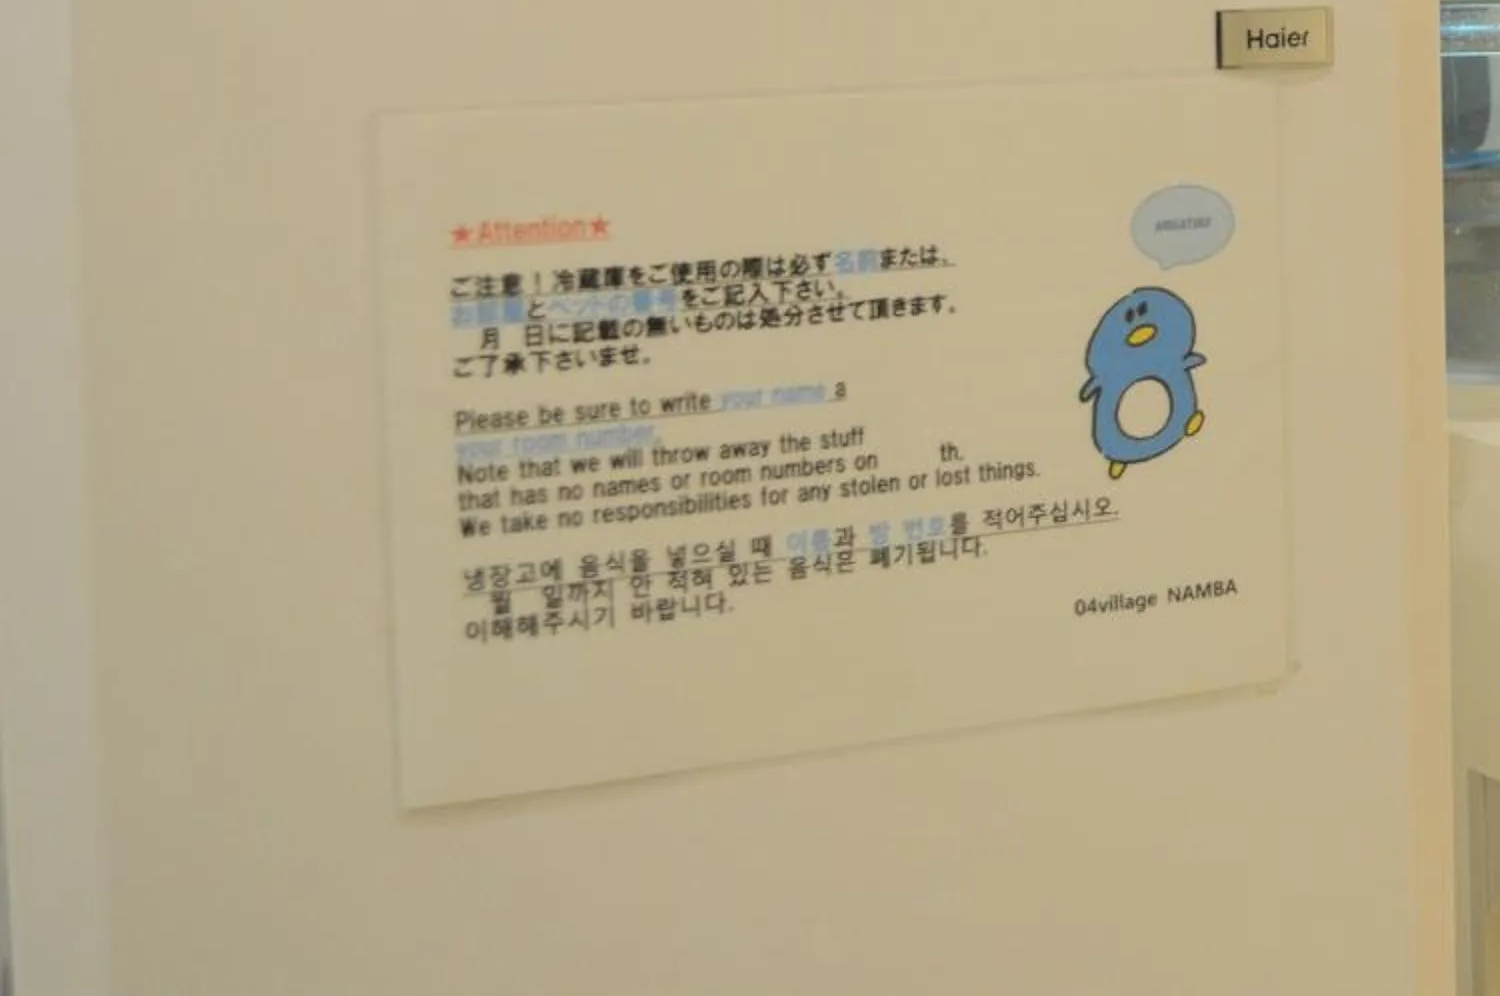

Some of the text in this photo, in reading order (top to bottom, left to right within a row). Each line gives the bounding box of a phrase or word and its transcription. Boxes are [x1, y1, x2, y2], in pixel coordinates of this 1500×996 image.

[1246, 27, 1309, 49] Haier
[478, 217, 586, 241] Attention
[480, 326, 500, 350] 月
[455, 408, 529, 430] Please
[538, 405, 564, 424] be
[575, 401, 622, 422] sure
[630, 397, 651, 416] to
[660, 392, 712, 413] write
[834, 381, 847, 399] a
[458, 425, 864, 485] Note that we will throw away the stuff
[459, 441, 965, 512] that has no names or room numbers on th.
[460, 459, 1041, 539] We take no responsibilities for any stolen or lost things.
[463, 557, 563, 592] 냉장고에
[578, 547, 650, 580] 음식을
[667, 538, 737, 570] 넣으실
[751, 534, 773, 558] 때
[983, 496, 1120, 531] 적어주십시오.
[466, 590, 734, 643] 이해해주시기 바랍니다.
[1074, 578, 1238, 617] 04village NAMBA
